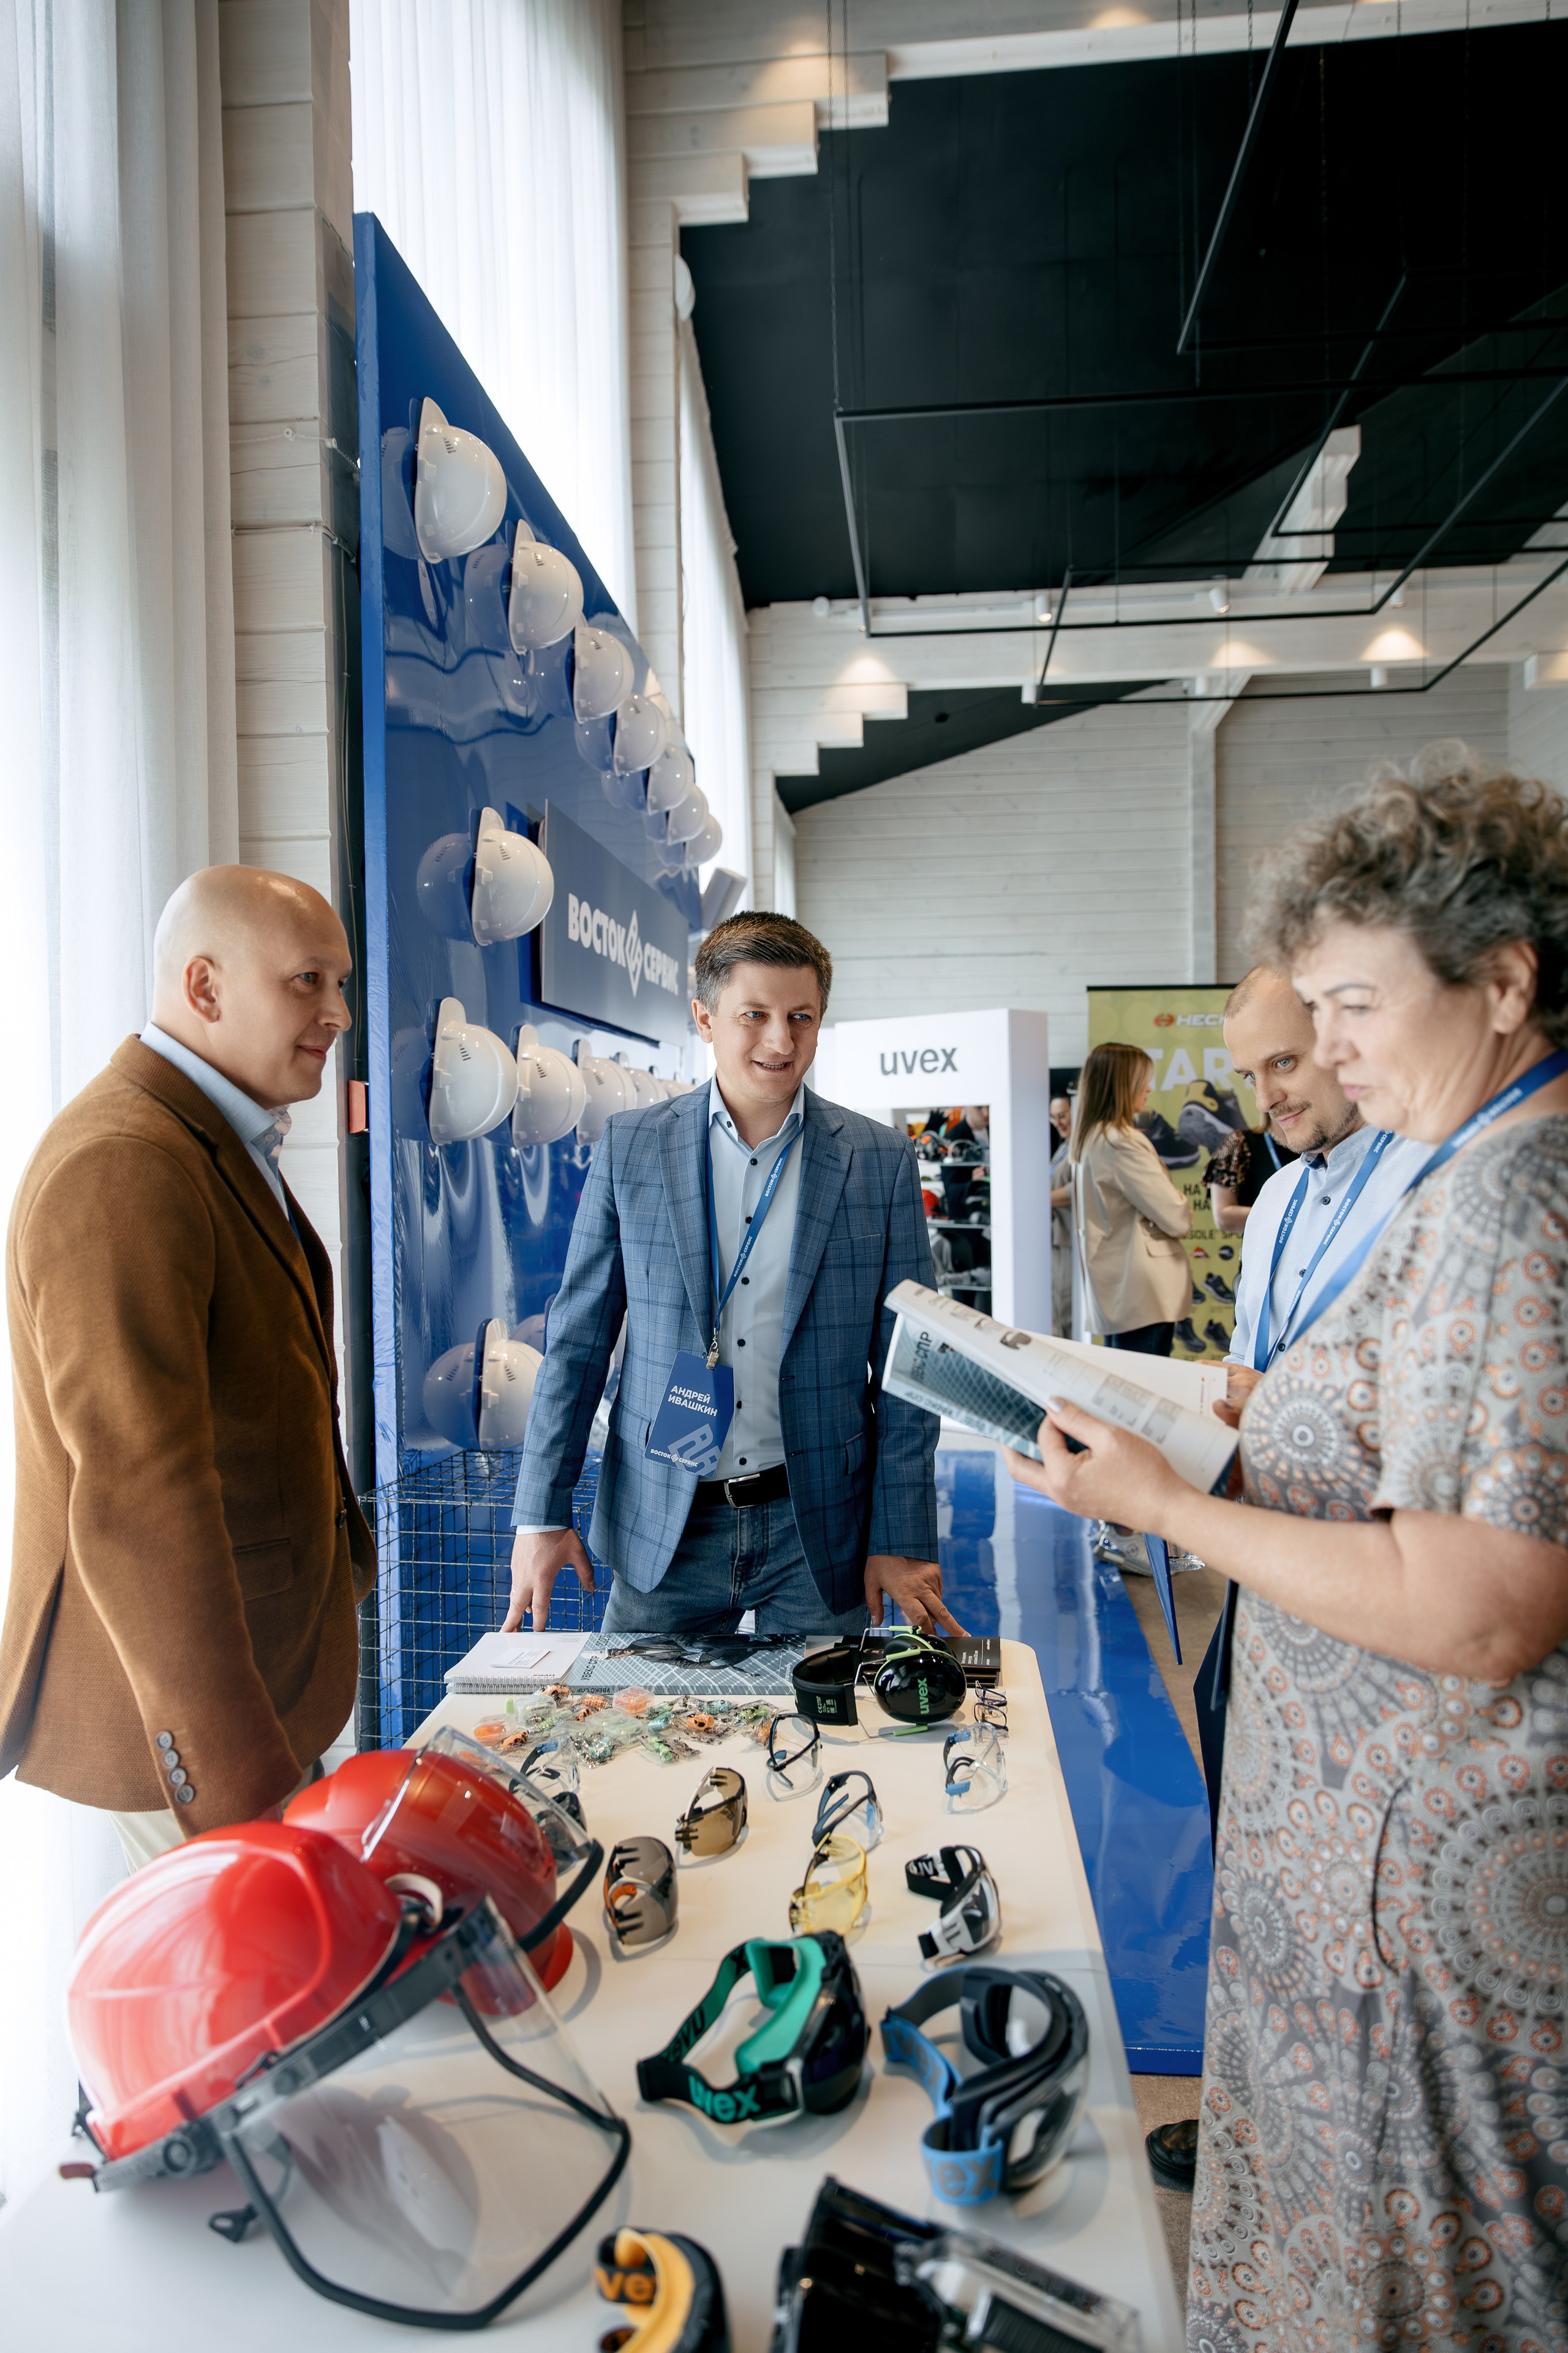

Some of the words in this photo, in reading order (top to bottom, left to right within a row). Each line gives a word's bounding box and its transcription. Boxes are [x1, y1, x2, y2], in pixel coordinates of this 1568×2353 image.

[567, 893, 627, 969] ВОСТОК
[643, 942, 679, 995] СЕРВИС
[1175, 1013, 1225, 1026] HEC
[880, 1048, 959, 1076] uvex
[764, 1177, 774, 1197] ВОСТОК
[774, 1157, 783, 1174] СЕРВИС
[1278, 1223, 1289, 1244] ВОСТОК
[1288, 1198, 1298, 1217] СЕРВИС
[1339, 1198, 1351, 1220] ВОСТОК
[1322, 1226, 1336, 1245] СЕРВИС
[733, 1258, 744, 1278] ВОСТОК
[743, 1235, 753, 1253] СЕРВИС
[667, 1394, 718, 1418] ИВАШКИН
[670, 1384, 711, 1405] АНДРЕЙ
[650, 1448, 671, 1459] ВОСТОК
[678, 1457, 699, 1468] СЕРВИС
[579, 1665, 596, 1681] УВЕКС
[918, 1677, 930, 1715] uvex
